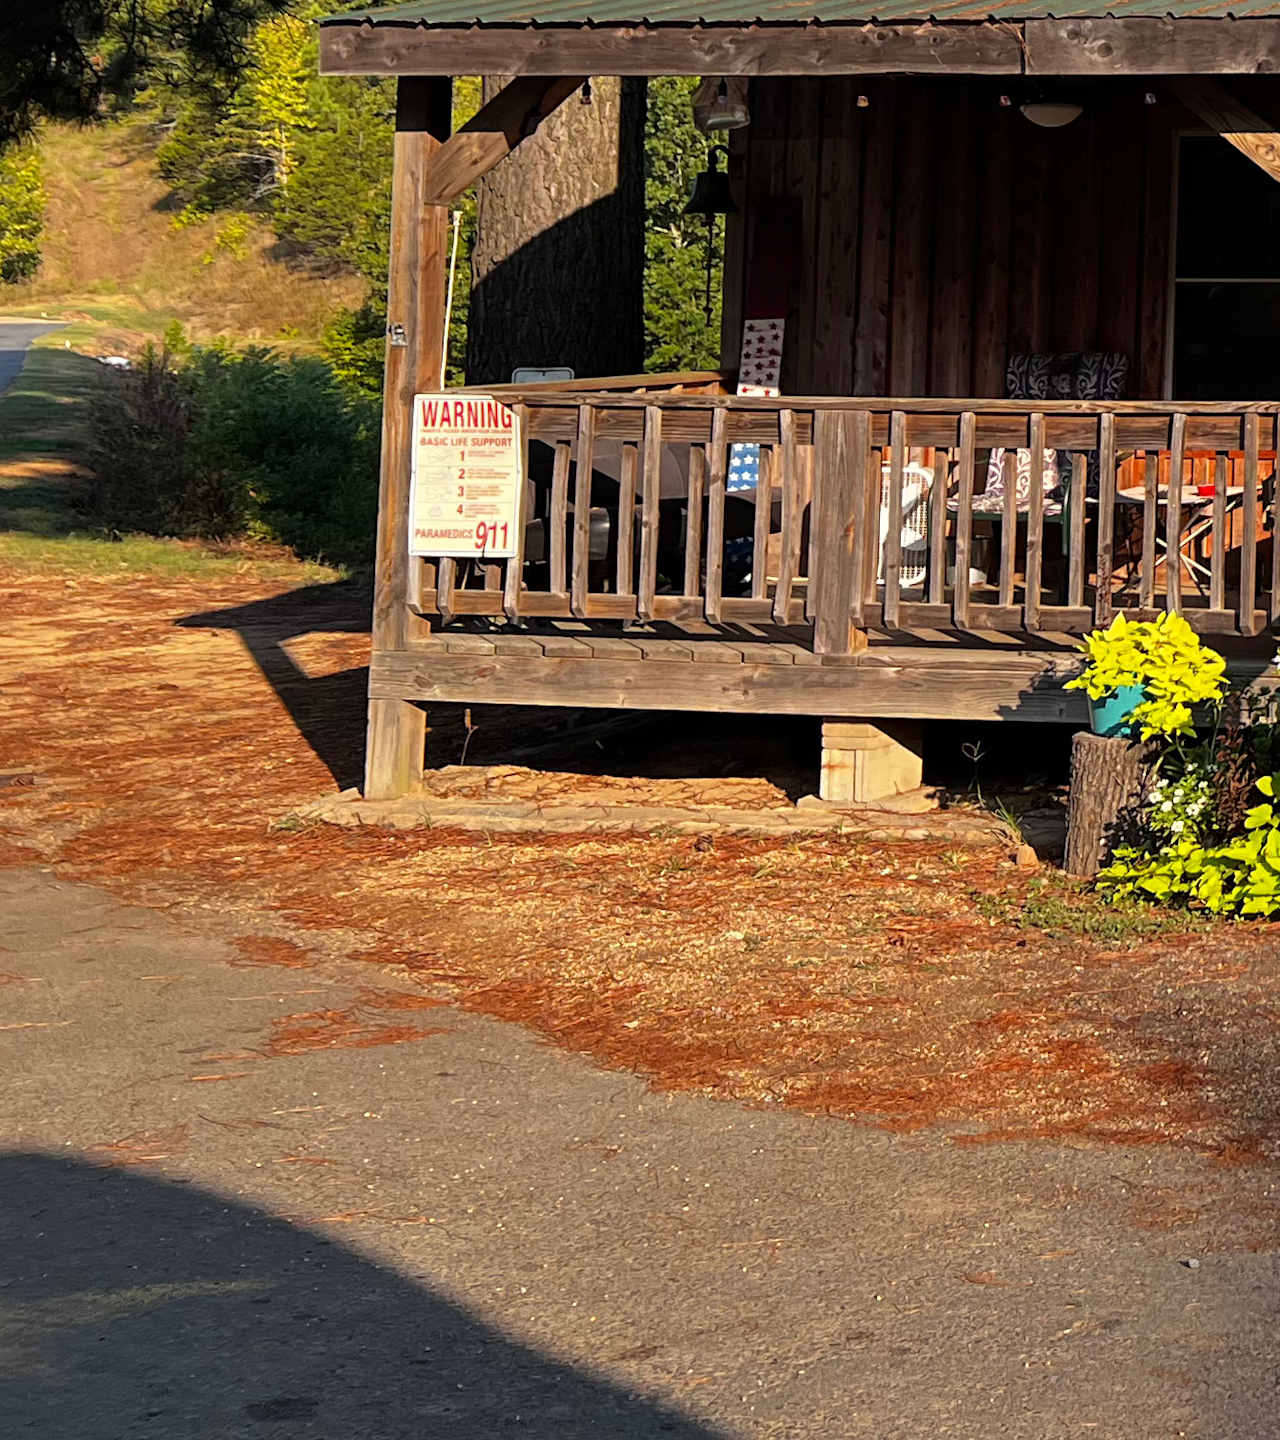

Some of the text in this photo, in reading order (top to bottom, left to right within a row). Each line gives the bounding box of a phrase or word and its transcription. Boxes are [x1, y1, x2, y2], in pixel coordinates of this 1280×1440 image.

[421, 400, 513, 429] WARNING
[420, 437, 513, 447] BASIC LIFE SUPPORT
[459, 450, 465, 461] 1
[458, 468, 465, 479] 2
[457, 485, 464, 496] 3
[456, 503, 464, 514] 4
[415, 521, 508, 549] PARAMEDICS 911
